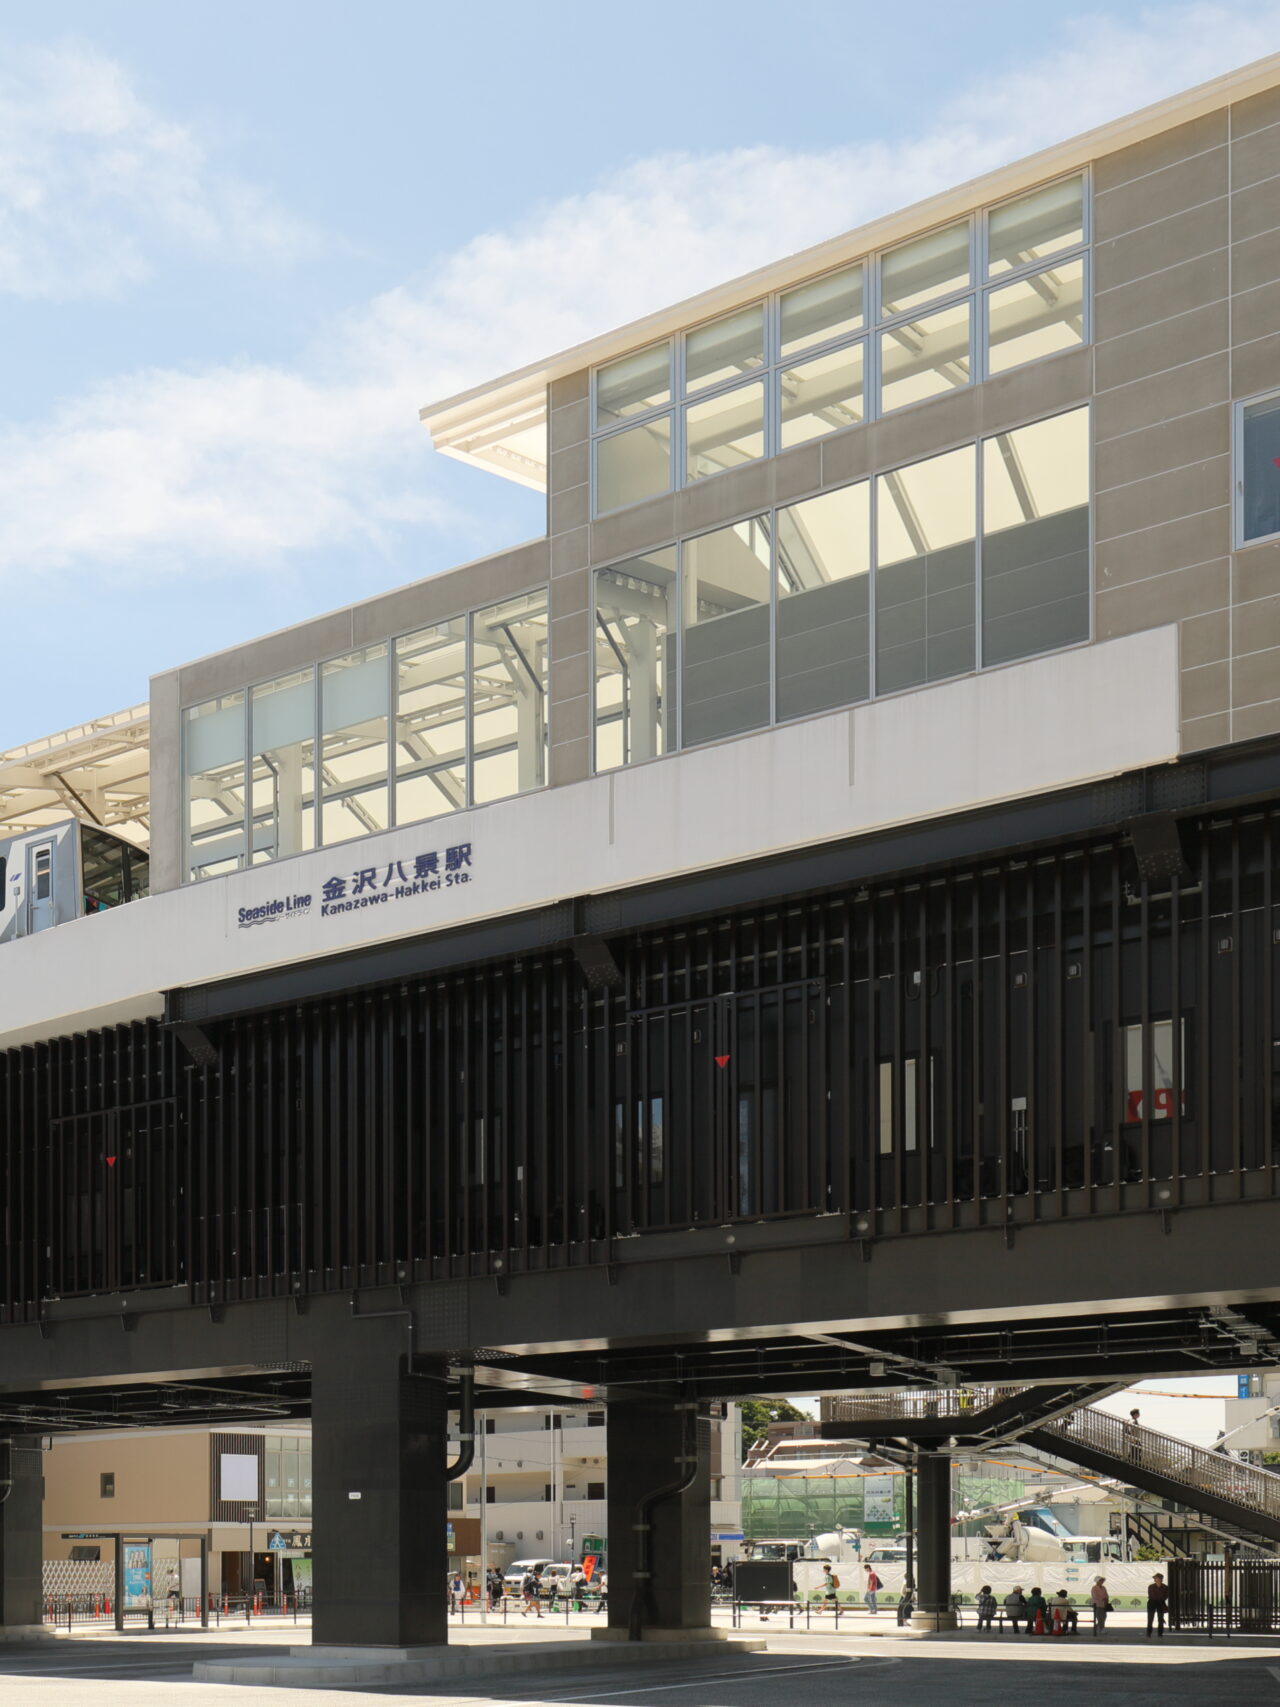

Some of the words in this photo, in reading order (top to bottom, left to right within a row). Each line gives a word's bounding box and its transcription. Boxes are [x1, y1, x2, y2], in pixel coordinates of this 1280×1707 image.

[322, 843, 472, 902] 金沢八景駅
[238, 899, 284, 923] Seaside
[286, 894, 312, 911] Line
[321, 876, 441, 917] Kanazawa-Hakkei
[445, 873, 472, 888] Sta.
